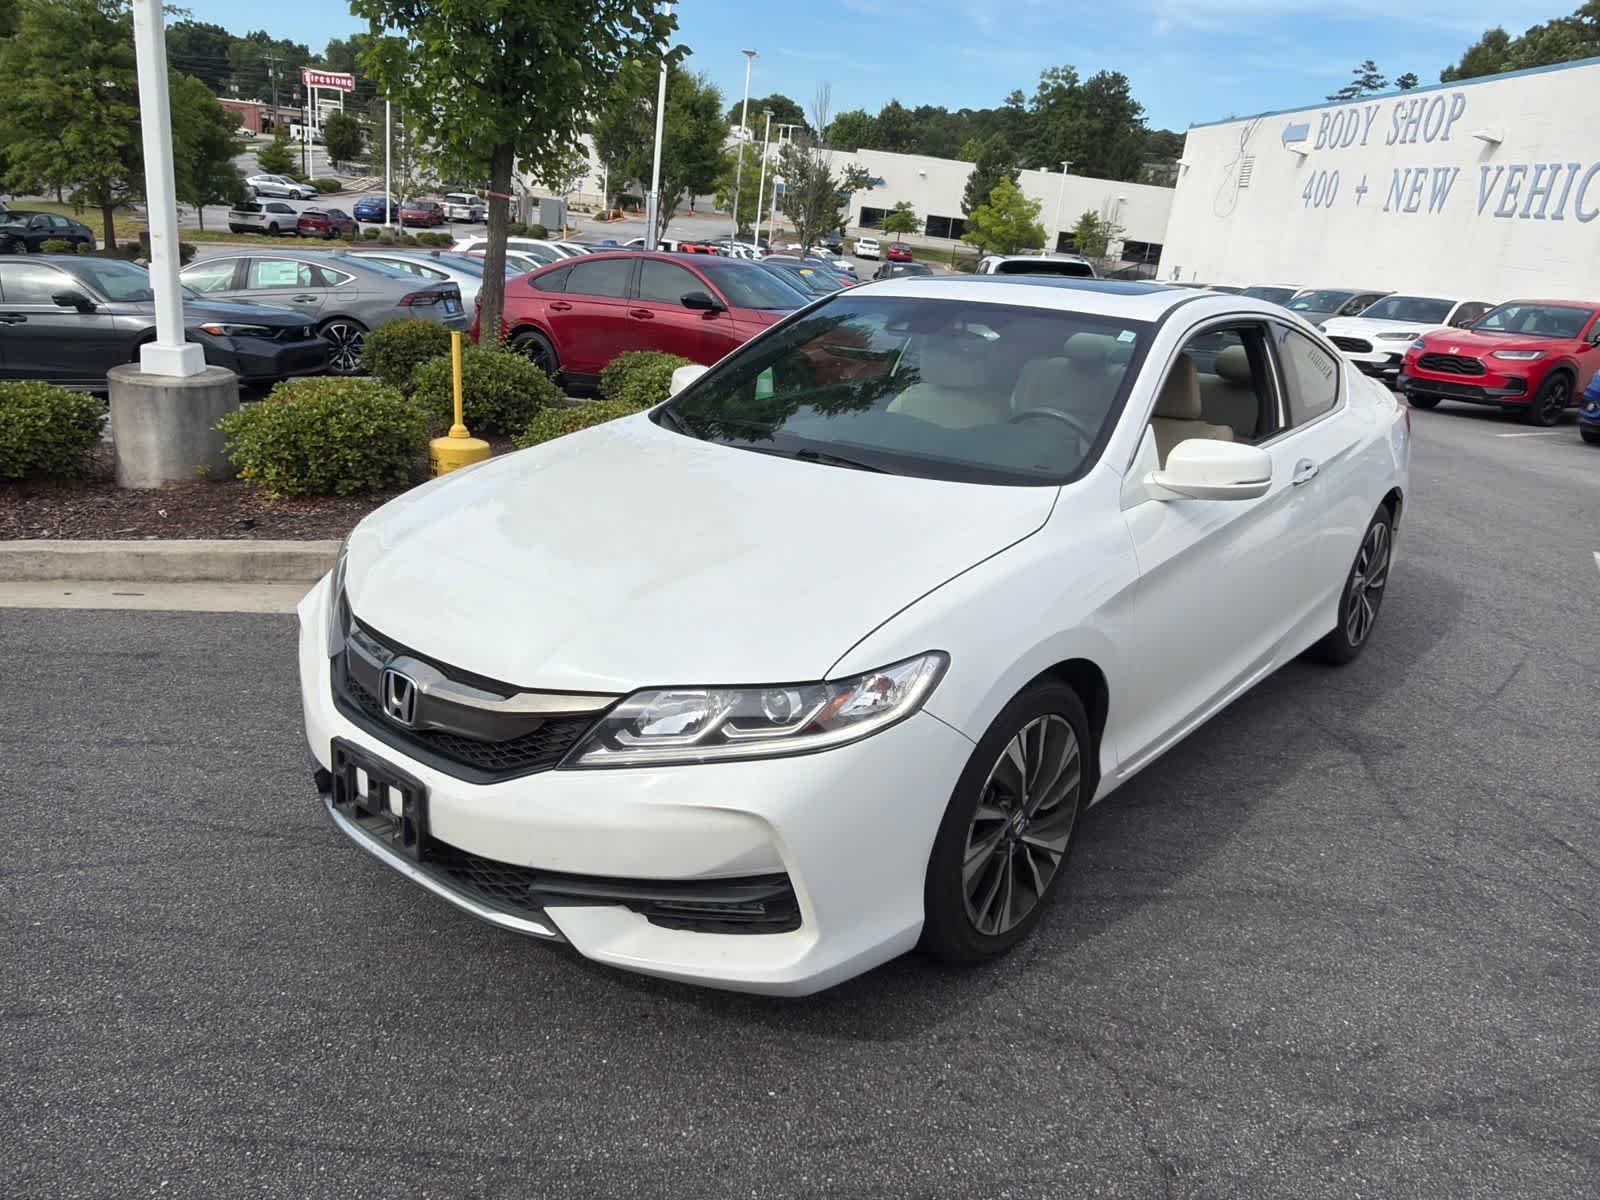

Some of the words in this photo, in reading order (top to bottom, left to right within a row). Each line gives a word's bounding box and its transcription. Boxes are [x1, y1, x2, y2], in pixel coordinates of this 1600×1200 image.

[1313, 105, 1381, 150] BODY
[1385, 93, 1466, 146] SHOP
[1302, 169, 1339, 209] 400
[1383, 167, 1460, 214] NEW
[1477, 161, 1600, 223] VEHIC
